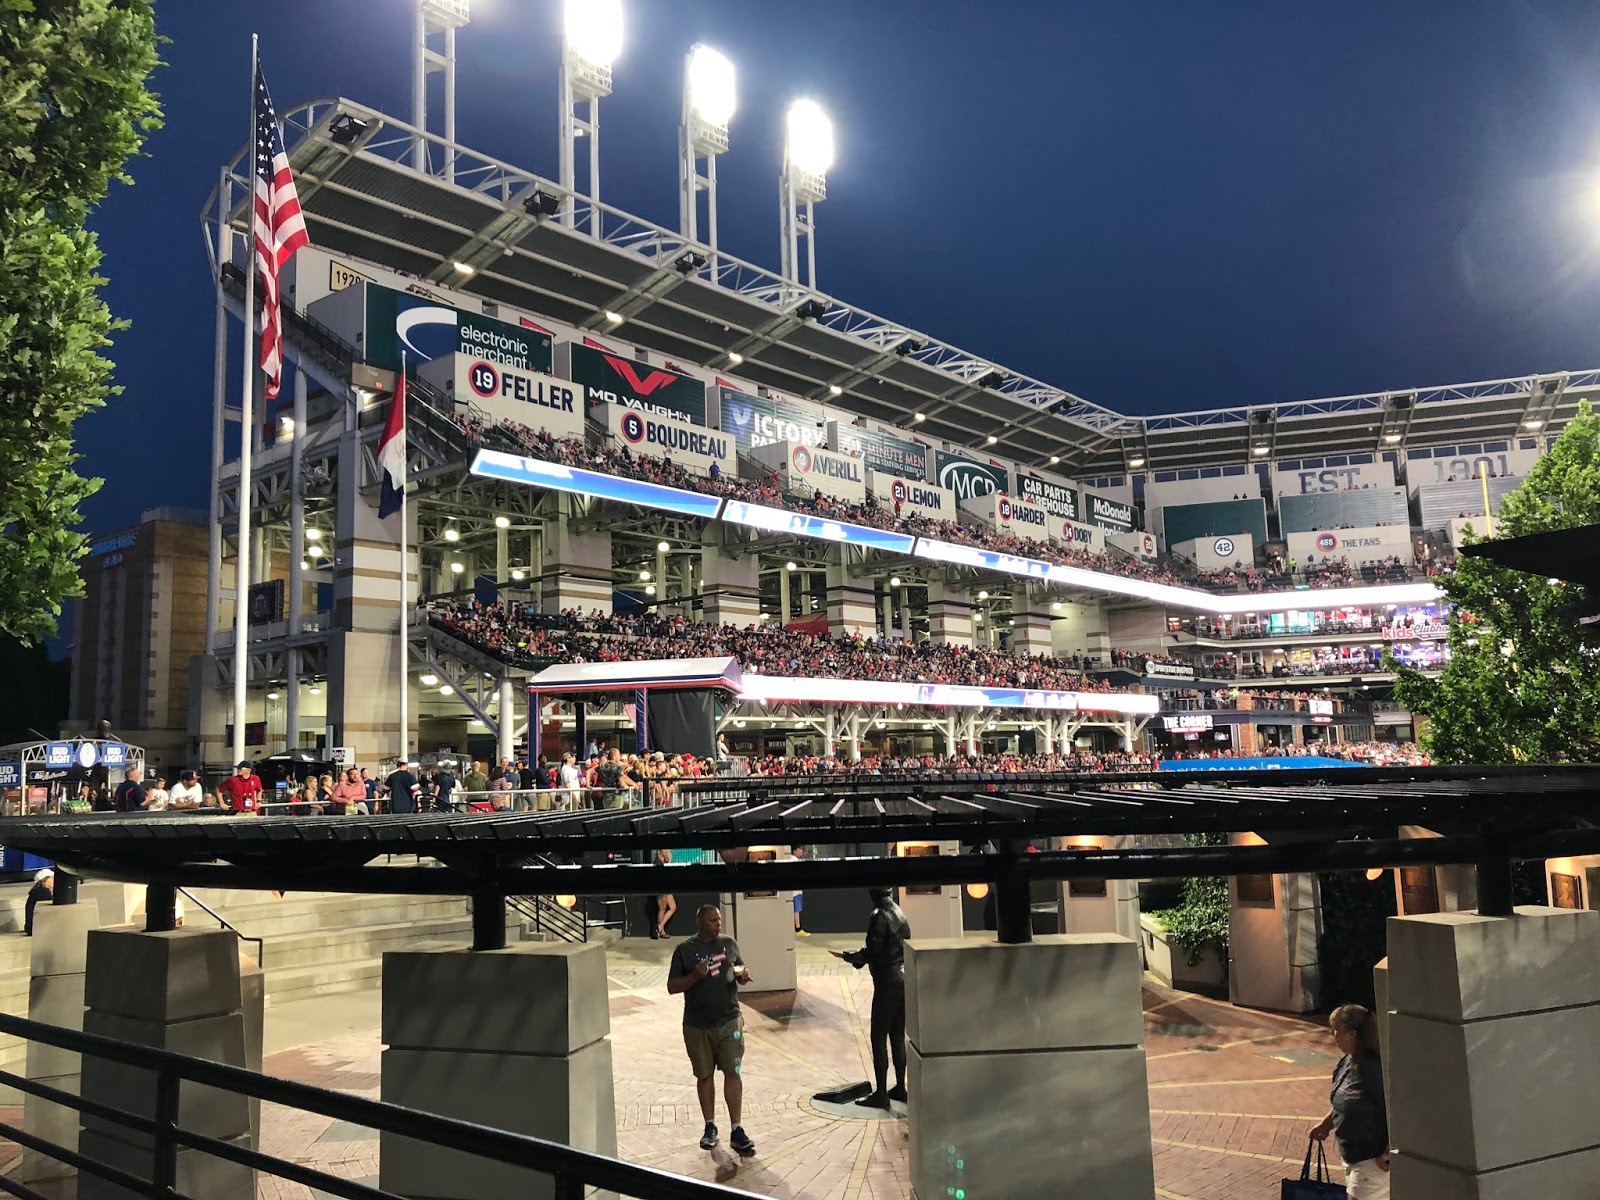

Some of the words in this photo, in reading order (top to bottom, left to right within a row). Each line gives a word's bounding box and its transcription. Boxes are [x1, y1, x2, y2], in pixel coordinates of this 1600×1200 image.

[461, 324, 529, 355] electronic
[461, 341, 528, 370] merchant
[475, 369, 494, 389] 19
[501, 372, 574, 413] FELLER
[589, 386, 617, 404] MO
[622, 395, 692, 424] VAUGHN
[730, 407, 824, 447] VICTORY
[628, 419, 638, 435] 5
[646, 420, 727, 460] BOUDREAU
[867, 441, 903, 463] MINUTE
[905, 452, 925, 468] MEN
[799, 452, 806, 466] 3
[812, 453, 862, 483] AVERILL
[904, 464, 925, 477] SERVICES
[1433, 454, 1508, 483] 1901
[895, 485, 904, 499] 21
[907, 485, 941, 510] LEMON
[1024, 478, 1043, 496] CAR
[1044, 484, 1072, 504] PARTS
[1001, 503, 1010, 516] 18
[1011, 503, 1046, 527] HARDER
[1022, 491, 1075, 518] WAREHOUSE
[1093, 498, 1132, 522] McDonald
[1065, 526, 1073, 538] 14
[1073, 526, 1093, 545] DOBY
[1215, 542, 1231, 552] 42
[1341, 538, 1358, 548] THE
[1359, 537, 1381, 547] FANS
[1412, 622, 1449, 633] Clubho
[1162, 716, 1179, 729] THE
[1179, 714, 1214, 728] CORNER
[49, 754, 71, 764] LIGHT
[52, 746, 69, 756] BUD
[104, 754, 123, 763] LIGHT
[106, 746, 122, 755] BUD
[0, 765, 14, 775] UD
[0, 774, 18, 784] GHT
